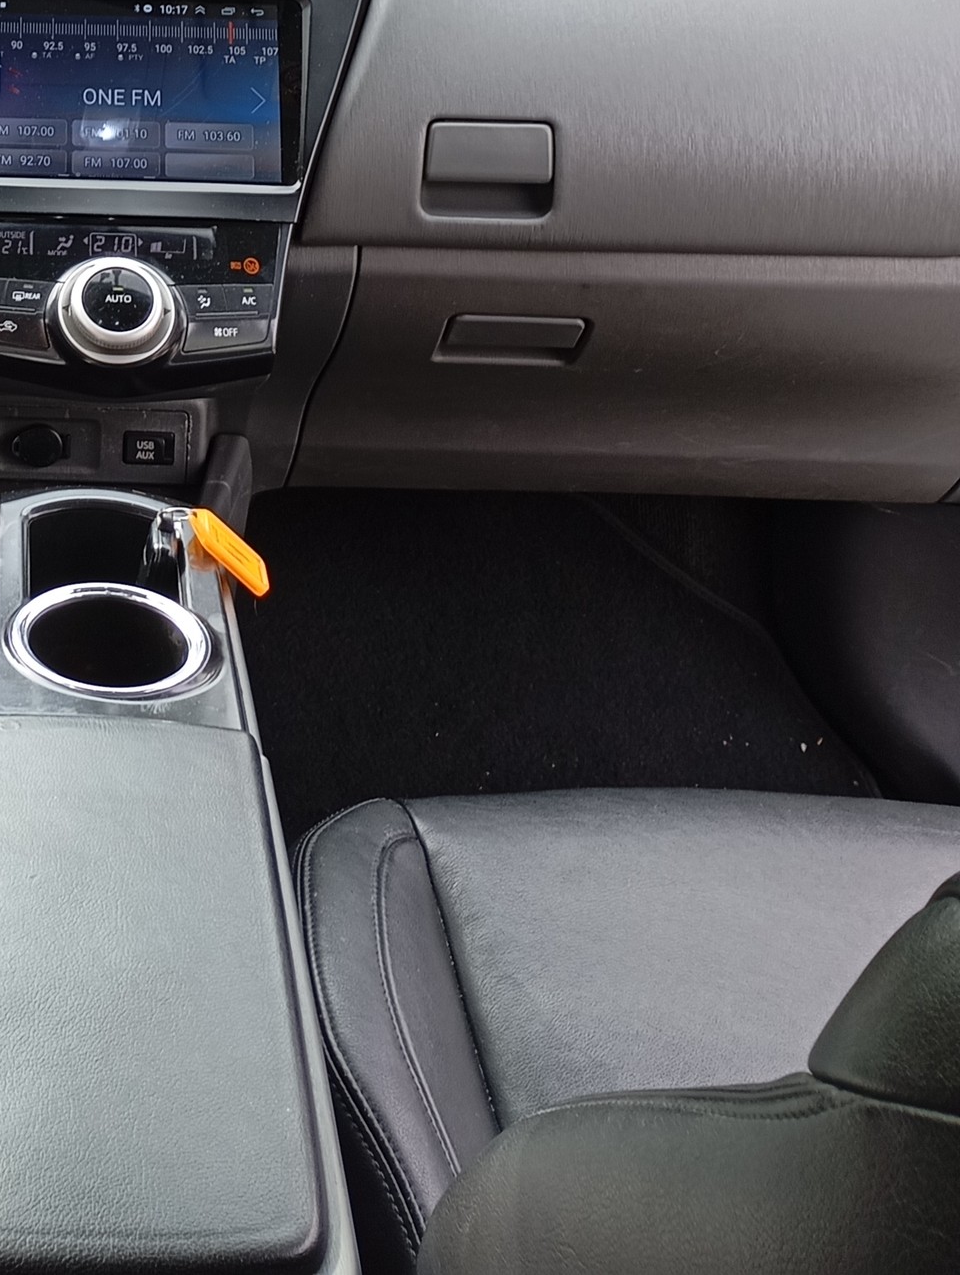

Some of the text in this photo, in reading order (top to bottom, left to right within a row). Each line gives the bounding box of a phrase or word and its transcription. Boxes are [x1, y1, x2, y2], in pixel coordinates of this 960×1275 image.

[159, 4, 188, 16] 10:17
[11, 40, 23, 50] 90
[43, 40, 64, 51] 92.5
[84, 42, 97, 52] 95
[116, 43, 137, 53] 97.5
[155, 44, 173, 54] 100
[188, 45, 214, 55] 102.5
[229, 46, 246, 55] 105
[223, 55, 236, 64] TA
[254, 55, 266, 65] TP
[82, 87, 162, 107] ONE FM
[18, 125, 55, 137] 107.00
[178, 130, 241, 142] FM 103.60
[20, 155, 51, 167] 92.70
[84, 157, 148, 169] FM 107.00
[23, 292, 40, 300] REAR
[105, 294, 132, 304] AUTO
[241, 296, 257, 307] A/C
[222, 327, 239, 338] OFF
[136, 440, 155, 450] USB
[135, 450, 155, 461] AUX
